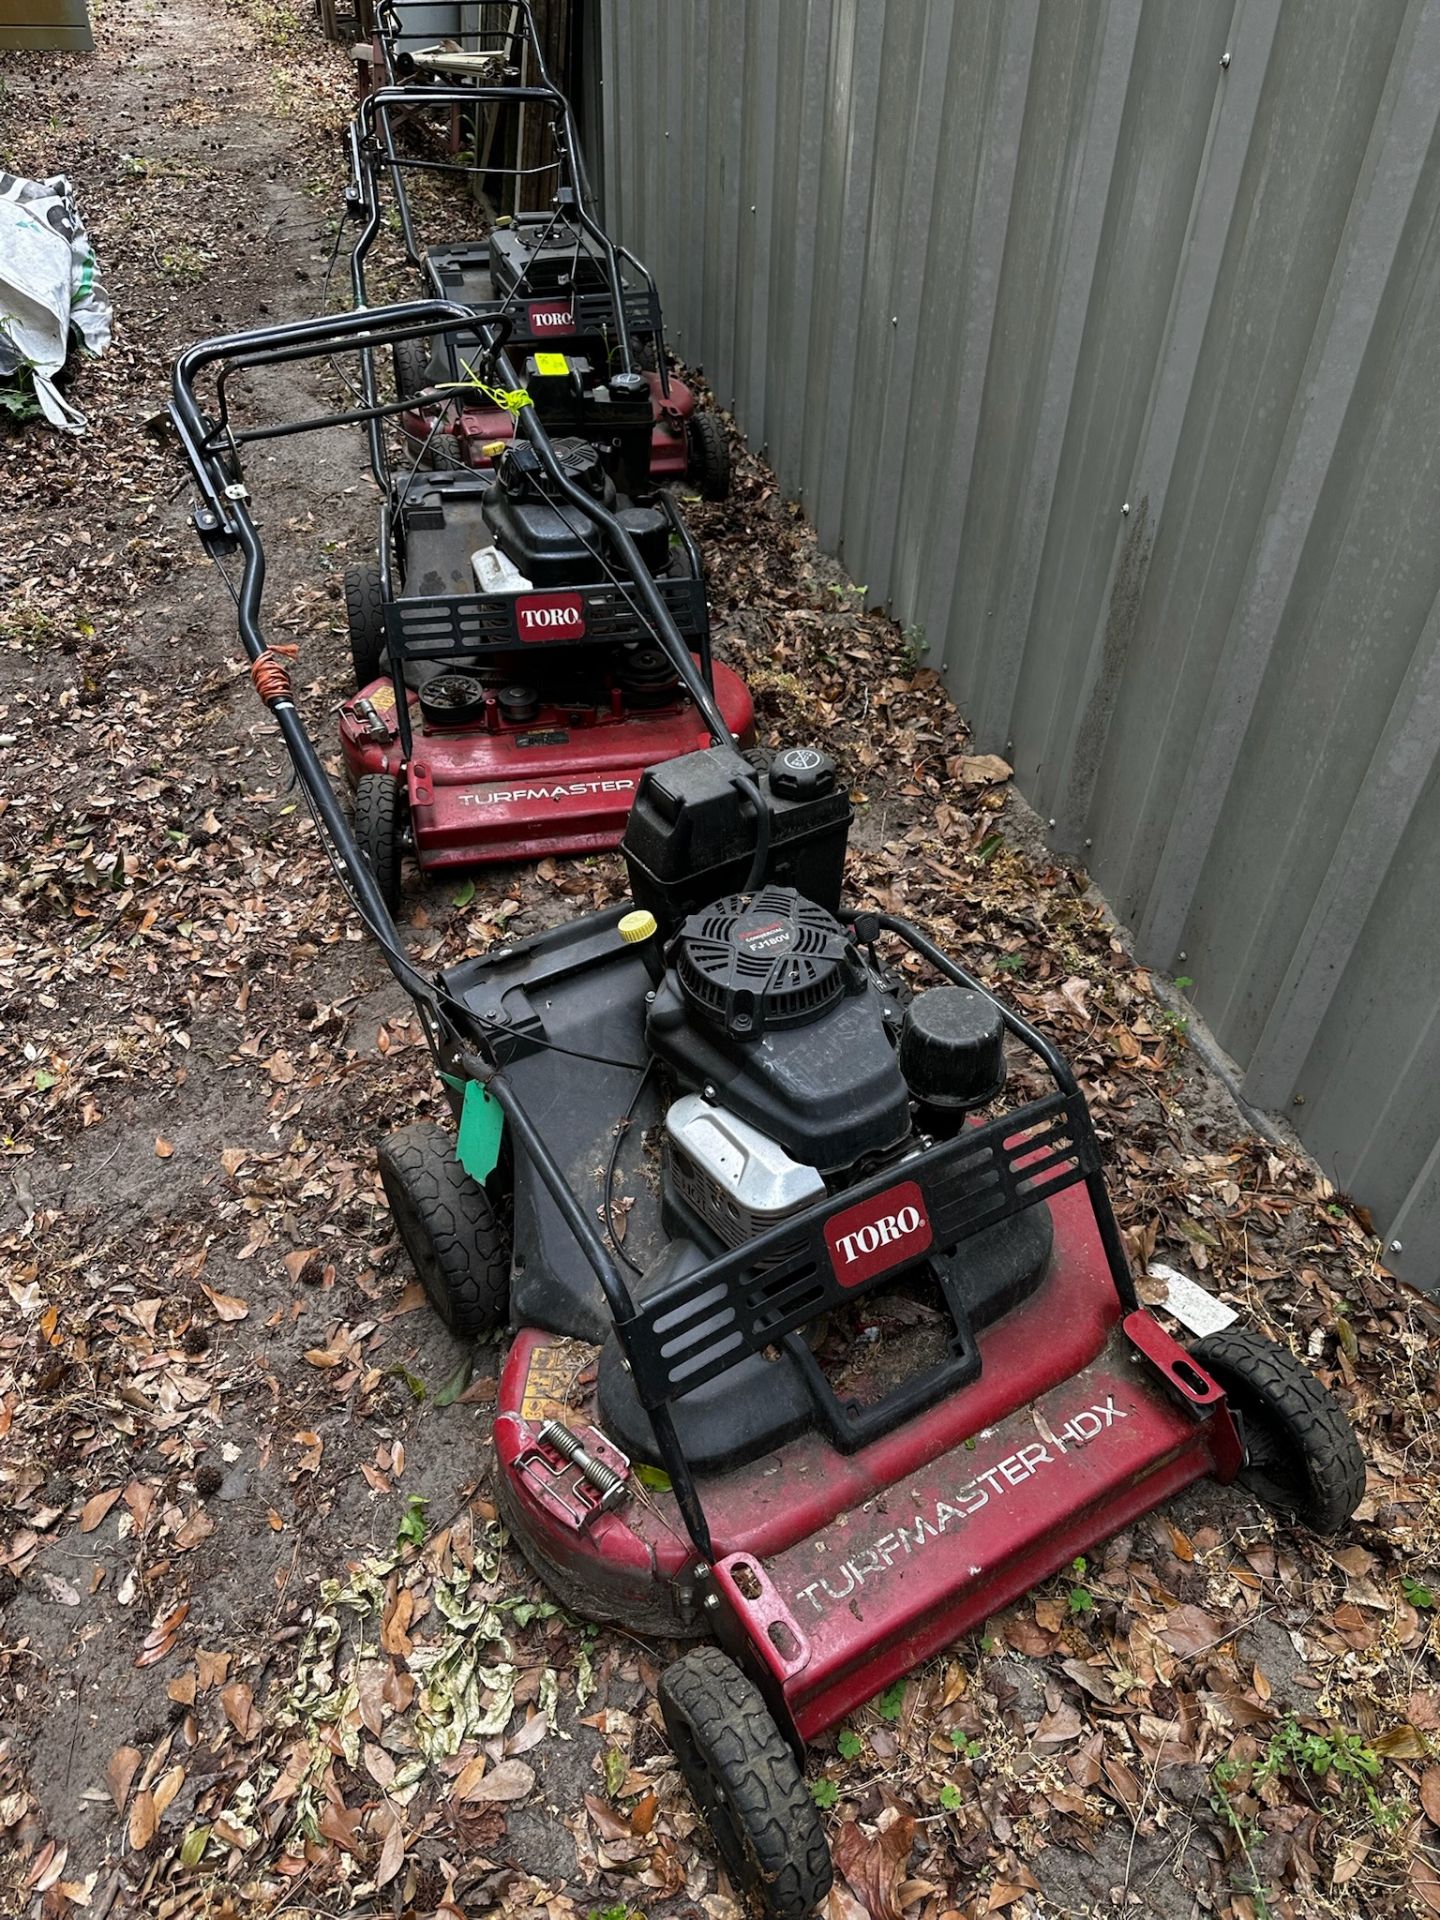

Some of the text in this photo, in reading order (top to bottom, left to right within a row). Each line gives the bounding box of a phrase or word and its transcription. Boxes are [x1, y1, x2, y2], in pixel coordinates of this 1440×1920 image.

[532, 311, 572, 327] TORO
[521, 607, 579, 628] TORO
[458, 779, 635, 806] TURFMASTER
[749, 932, 790, 951] FJ180V
[835, 1206, 920, 1265] TORO
[796, 1397, 1128, 1612] TURFMASTER HDX
